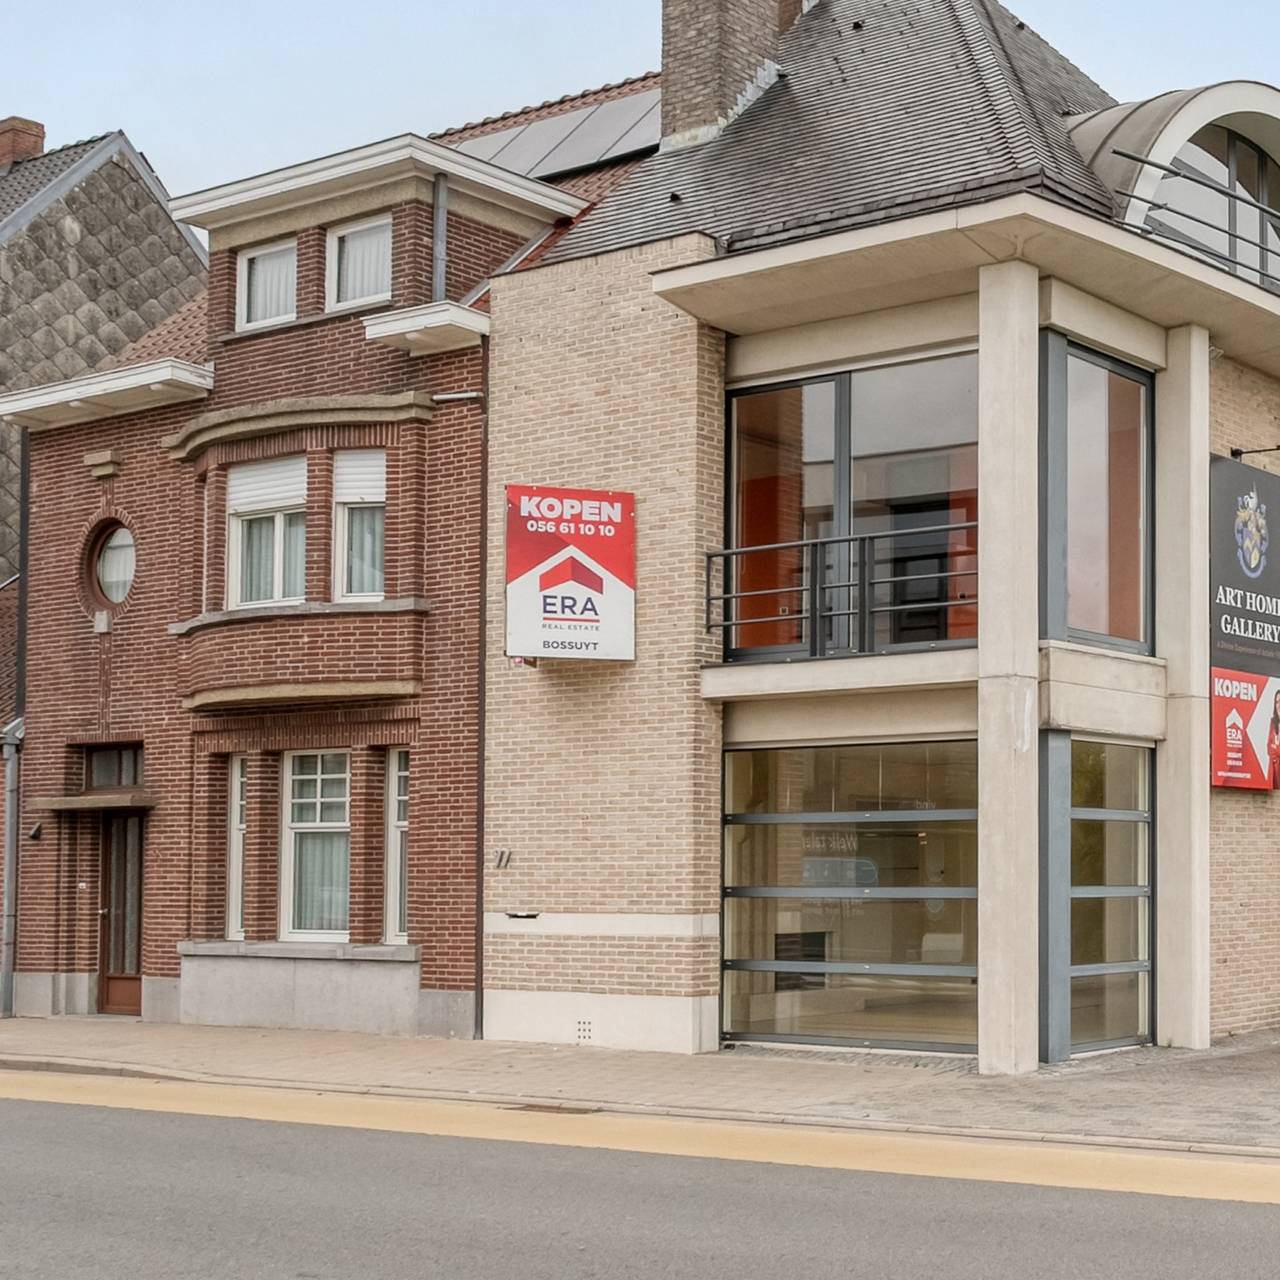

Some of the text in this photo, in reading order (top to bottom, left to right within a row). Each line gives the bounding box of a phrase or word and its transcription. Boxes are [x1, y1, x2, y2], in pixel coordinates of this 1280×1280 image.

[520, 496, 622, 523] KOPEN
[527, 520, 615, 536] 056 61 10 10
[543, 595, 599, 616] ERA
[1216, 585, 1244, 608] ART
[543, 640, 599, 651] BOSSUYT
[1214, 677, 1257, 701] KOPEN
[1226, 728, 1242, 740] ERA
